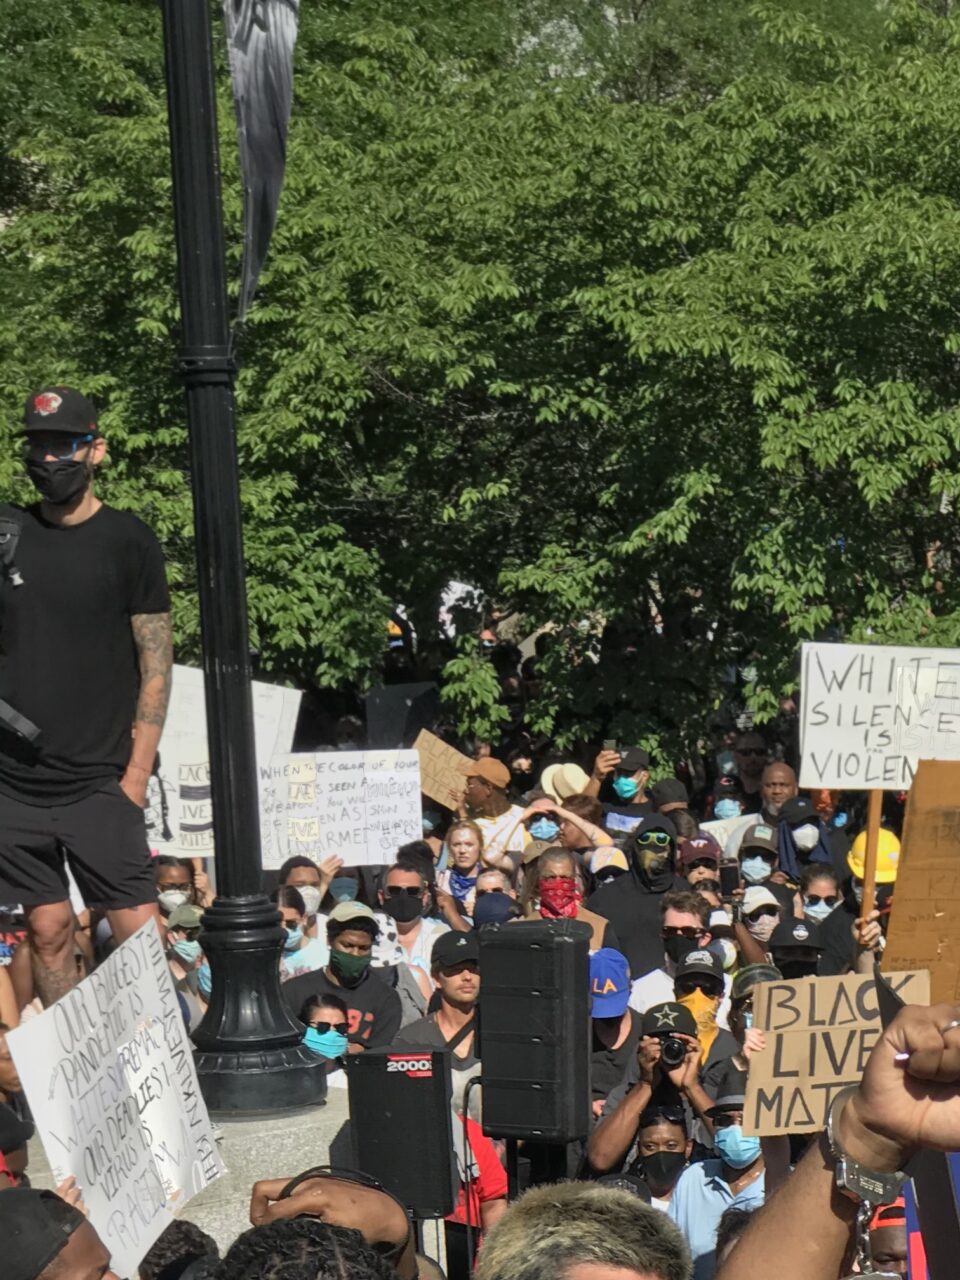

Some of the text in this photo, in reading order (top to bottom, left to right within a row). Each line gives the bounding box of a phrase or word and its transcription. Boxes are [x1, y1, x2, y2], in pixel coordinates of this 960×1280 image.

[864, 728, 892, 747] IS
[810, 750, 917, 783] VIOLEN
[592, 978, 618, 994] LA
[772, 1028, 880, 1078] LIVE
[755, 1081, 862, 1129] MAT
